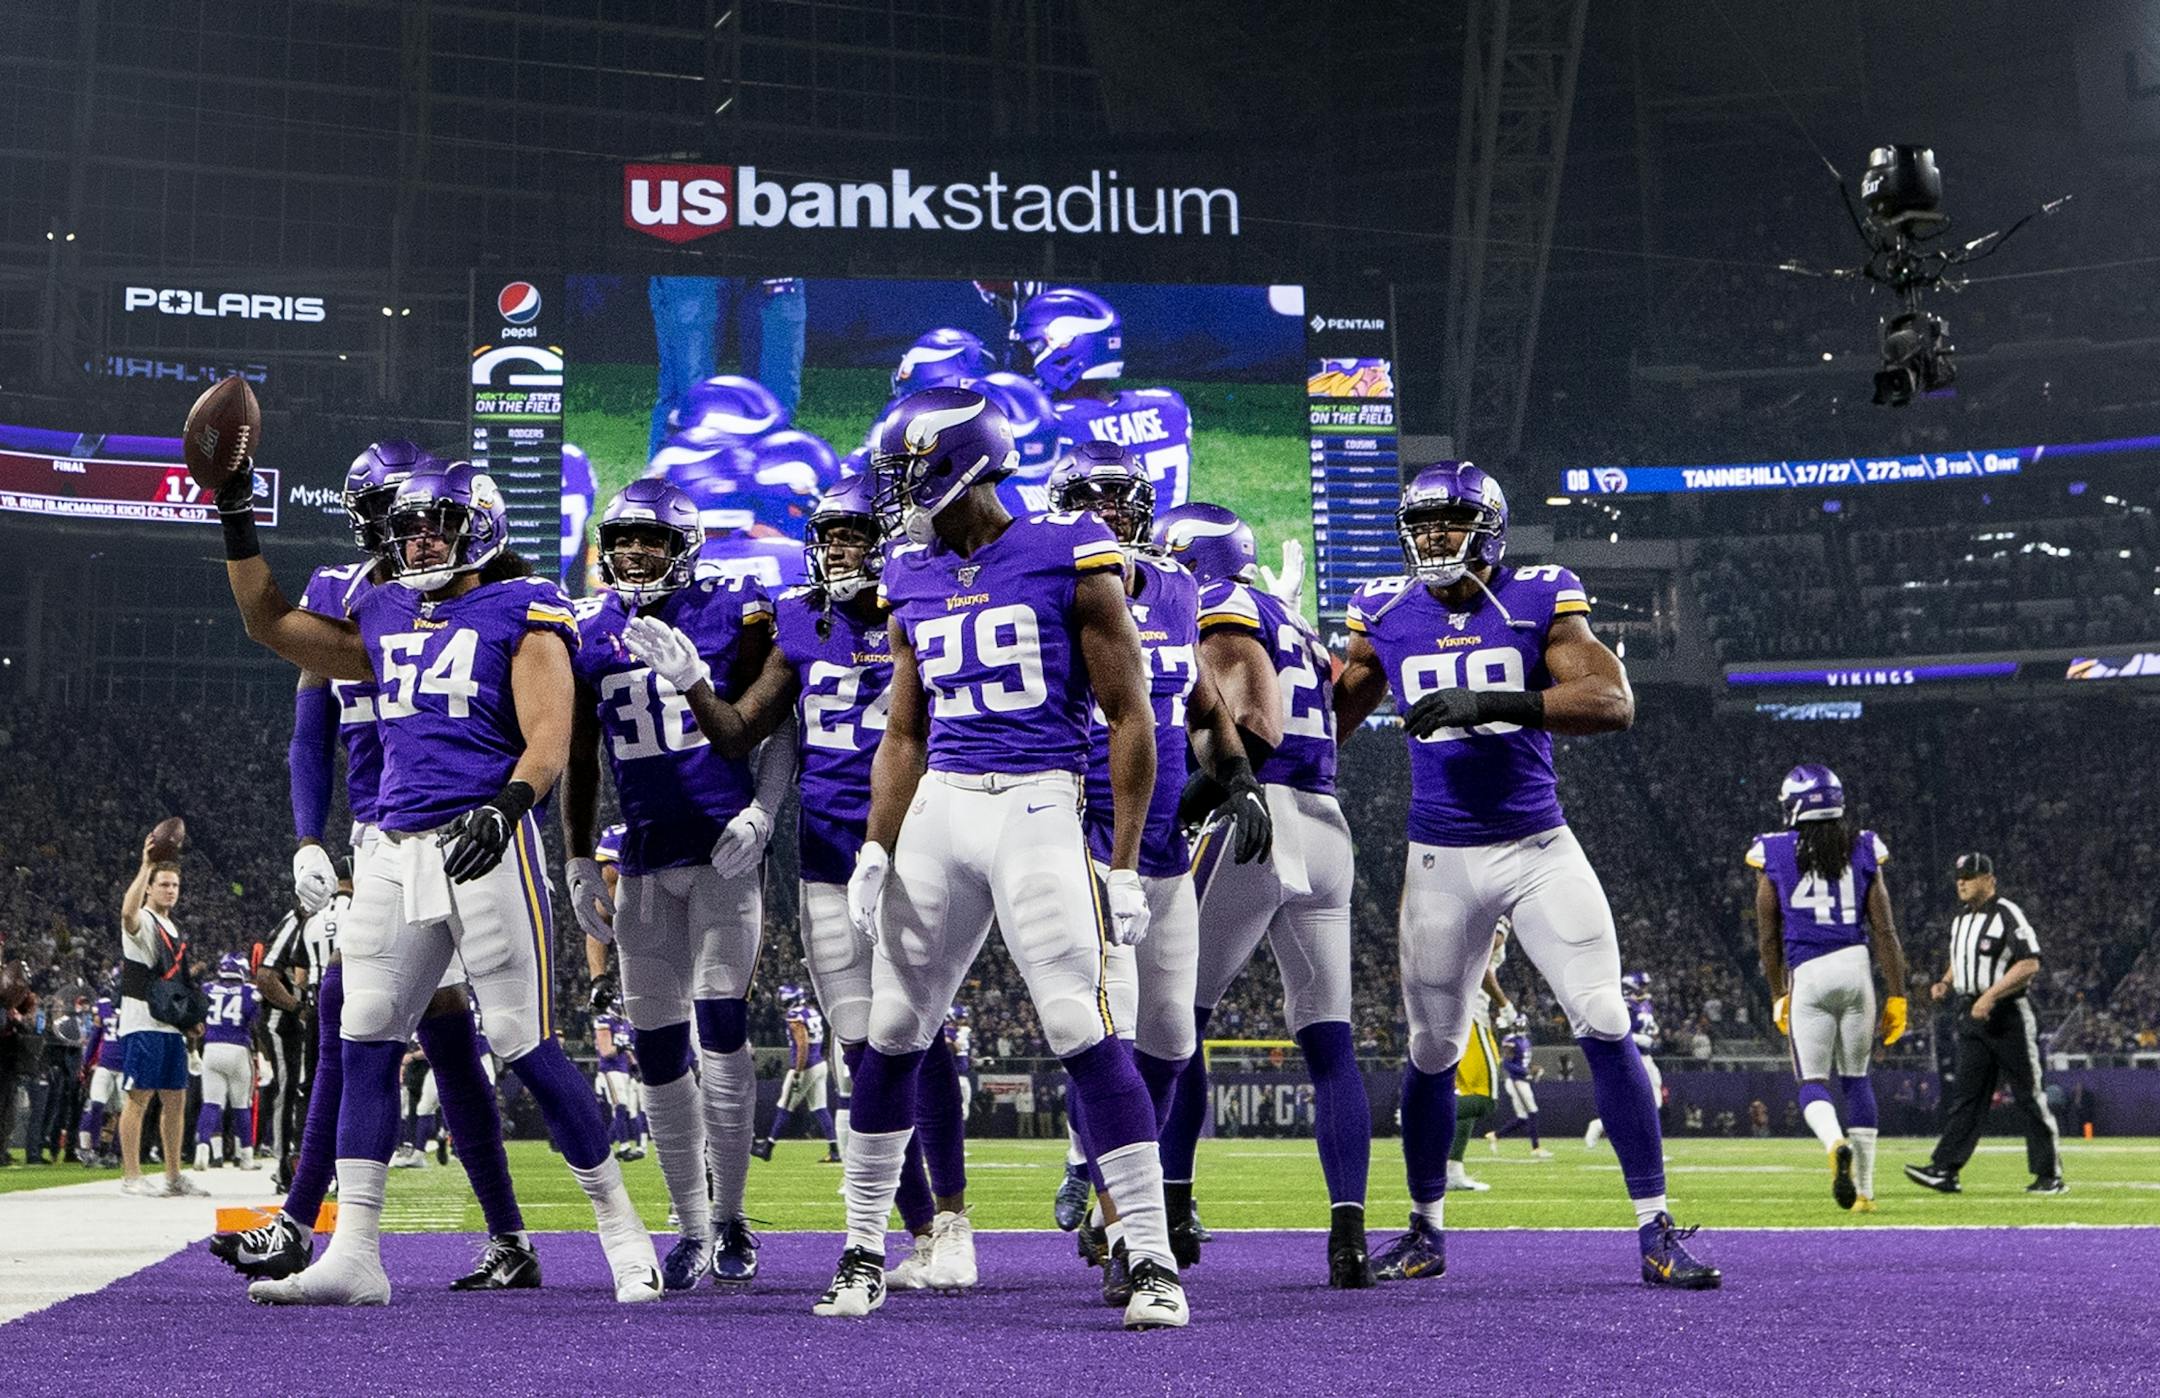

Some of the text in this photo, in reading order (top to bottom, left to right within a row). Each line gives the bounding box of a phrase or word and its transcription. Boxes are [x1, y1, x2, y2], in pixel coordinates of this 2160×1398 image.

[125, 285, 326, 322] POLARIS
[501, 326, 538, 339] pepsi
[1328, 319, 1385, 330] PENTAIR
[475, 392, 561, 401] NEXT GEN STATS
[475, 401, 561, 413] ON THE FIELD
[1310, 404, 1392, 413] NEXT GEN STATS
[1088, 408, 1169, 447] KEARSE
[1310, 412, 1393, 425] ON THE FIELD
[53, 460, 86, 473] FINAL
[1682, 466, 1786, 488] TANNEHILL
[1795, 463, 1850, 484] 17/27
[165, 476, 200, 503] 17
[945, 593, 989, 611] Vikings
[915, 604, 1048, 718] 29
[378, 627, 479, 721] 54
[1827, 671, 1915, 687] VIKINGS
[1790, 864, 1856, 925] 41
[206, 992, 243, 1027] 34
